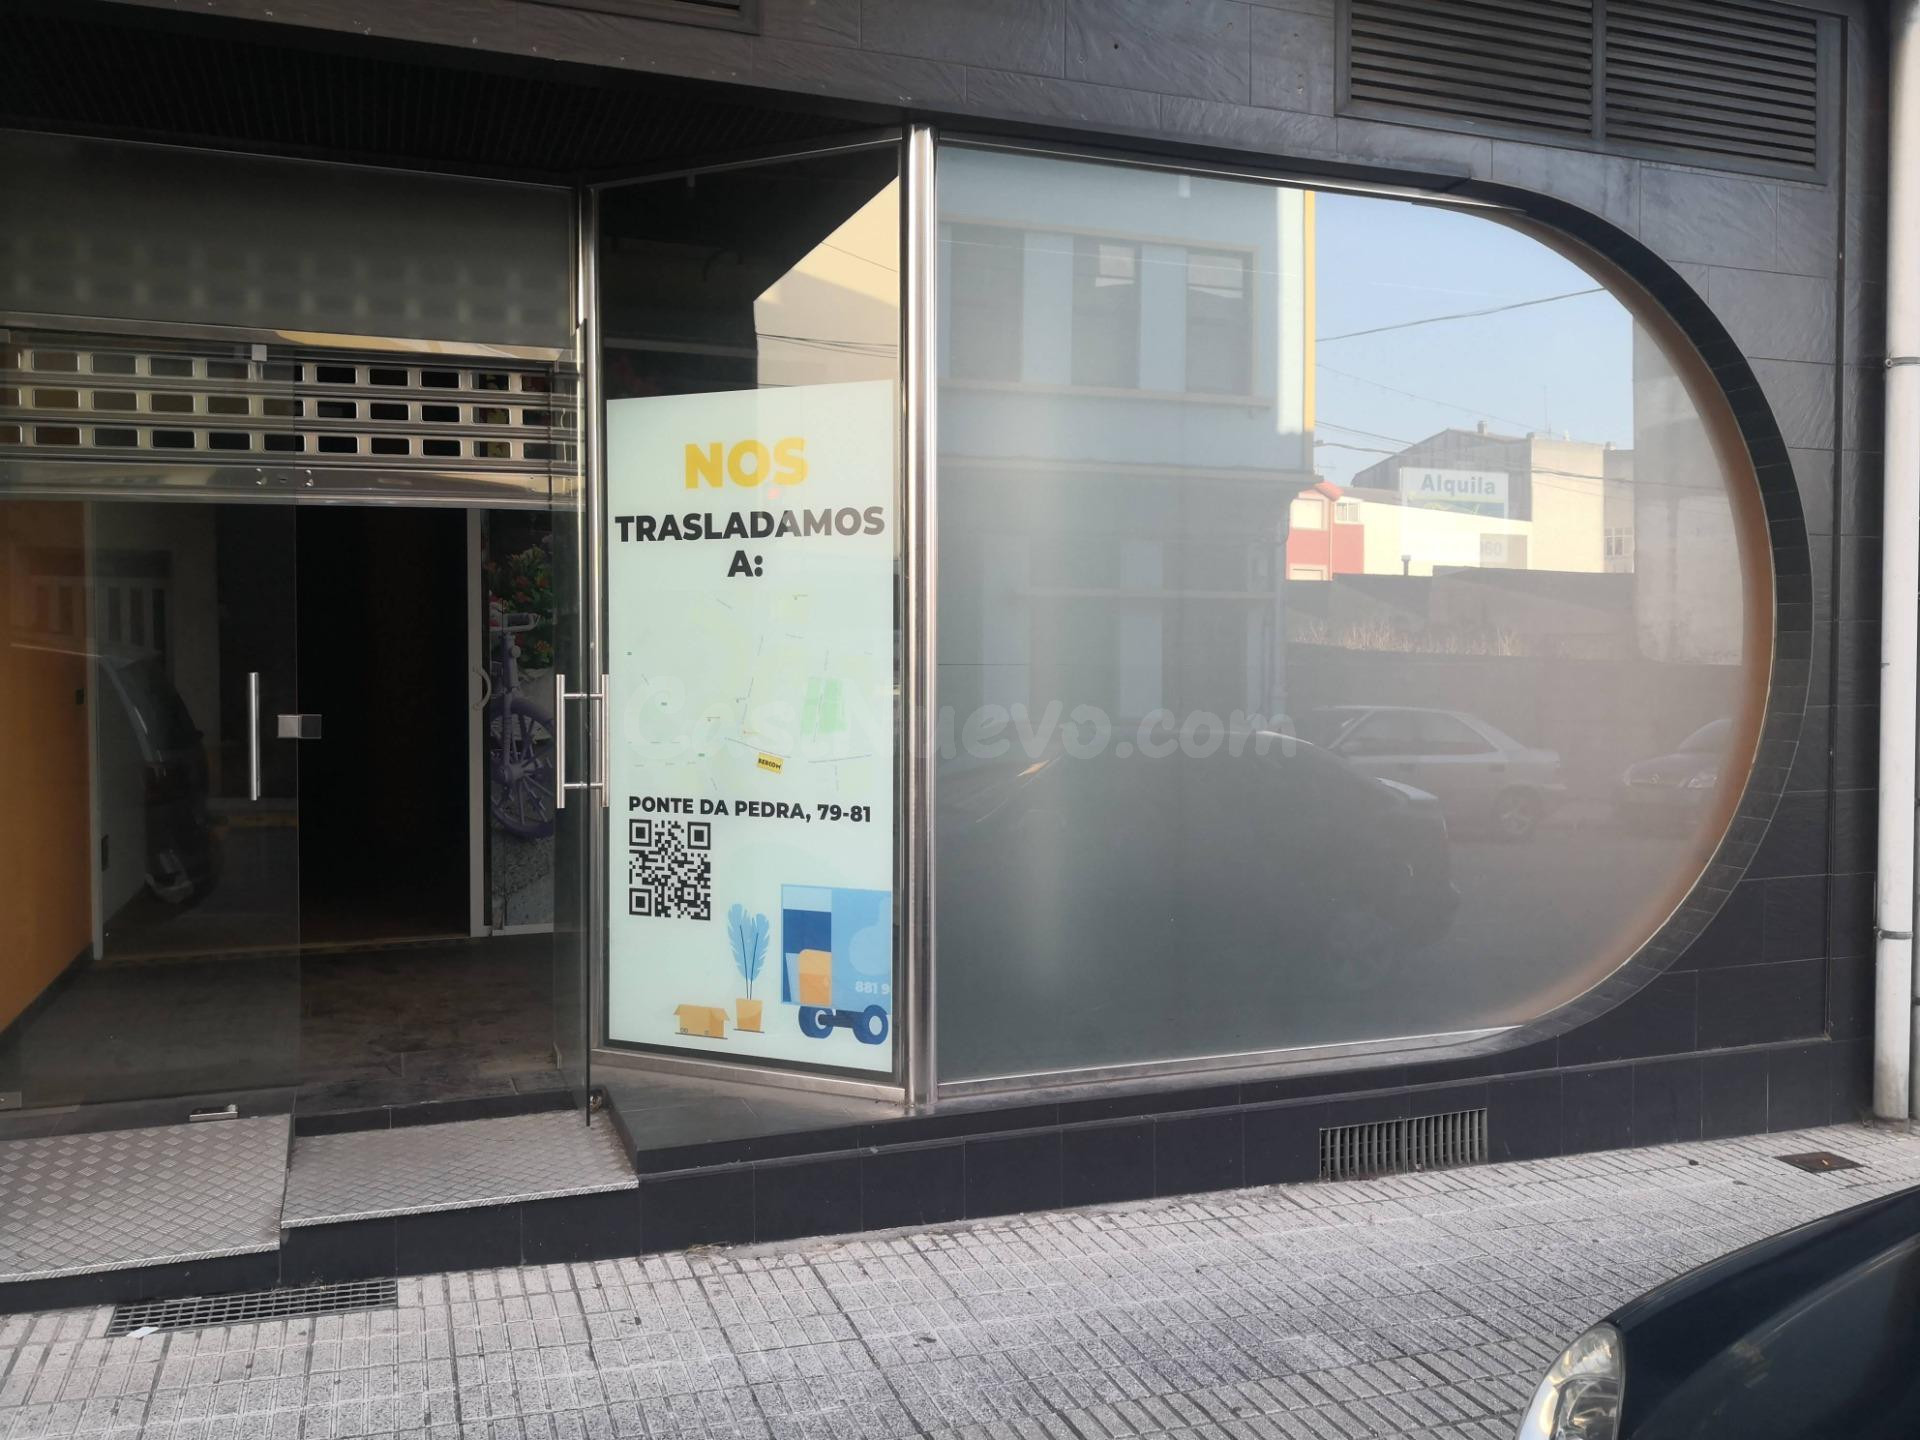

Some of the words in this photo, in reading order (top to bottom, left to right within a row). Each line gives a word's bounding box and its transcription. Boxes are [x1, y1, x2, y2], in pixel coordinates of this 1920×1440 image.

[684, 437, 809, 489] NOS
[1421, 473, 1495, 496] Alquila
[614, 506, 885, 542] TRASLADAMOS
[727, 550, 763, 577] A:
[628, 796, 694, 814] PONTE
[700, 799, 729, 816] DA
[734, 801, 812, 823] PEDRA,
[817, 804, 871, 823] 79-81
[855, 980, 878, 994] 881
